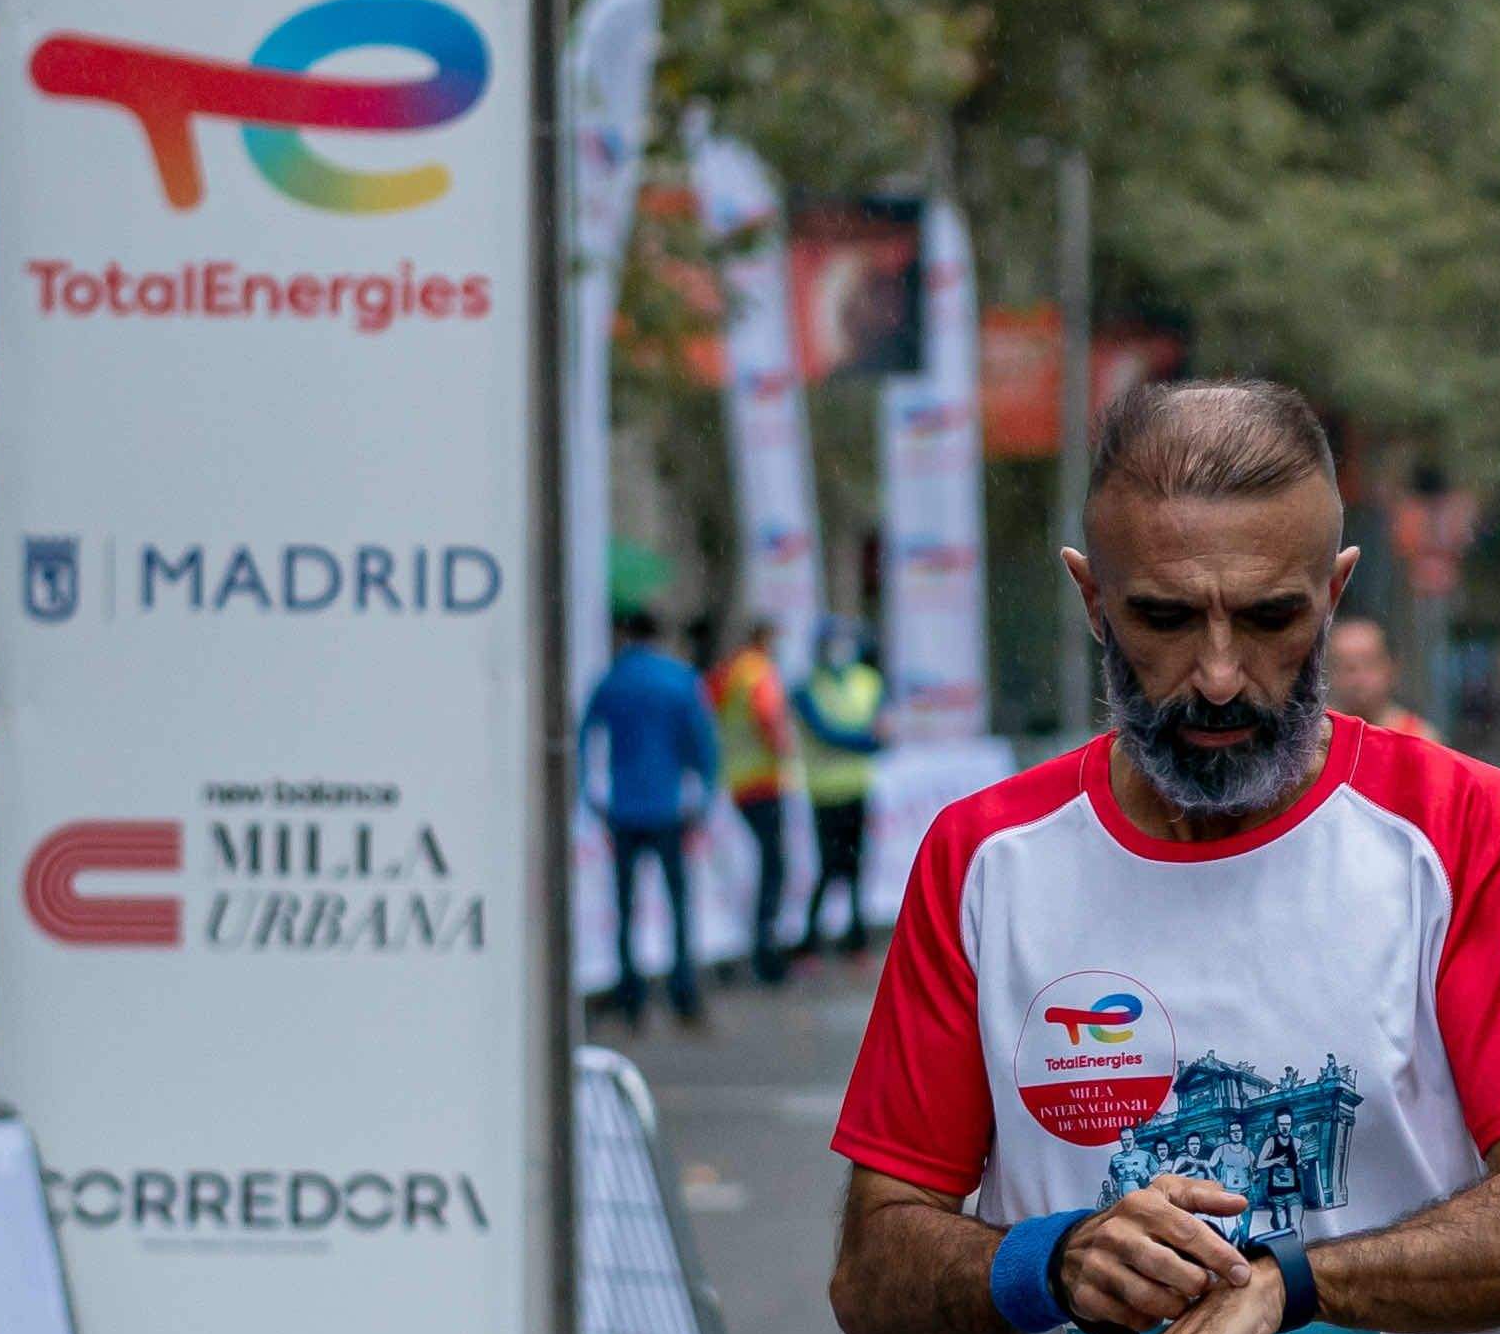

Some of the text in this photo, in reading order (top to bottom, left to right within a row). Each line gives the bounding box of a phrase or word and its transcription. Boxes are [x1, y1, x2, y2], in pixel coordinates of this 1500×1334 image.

[27, 258, 492, 335] TotalEnergies
[138, 543, 503, 615] MADRID
[205, 778, 399, 807] new balance
[210, 820, 450, 878] MILLA
[204, 890, 487, 953] URBANA
[1045, 1052, 1143, 1071] TotalEnergies
[1069, 1085, 1114, 1100] MILLA
[1058, 1116, 1135, 1132] DE MADRID
